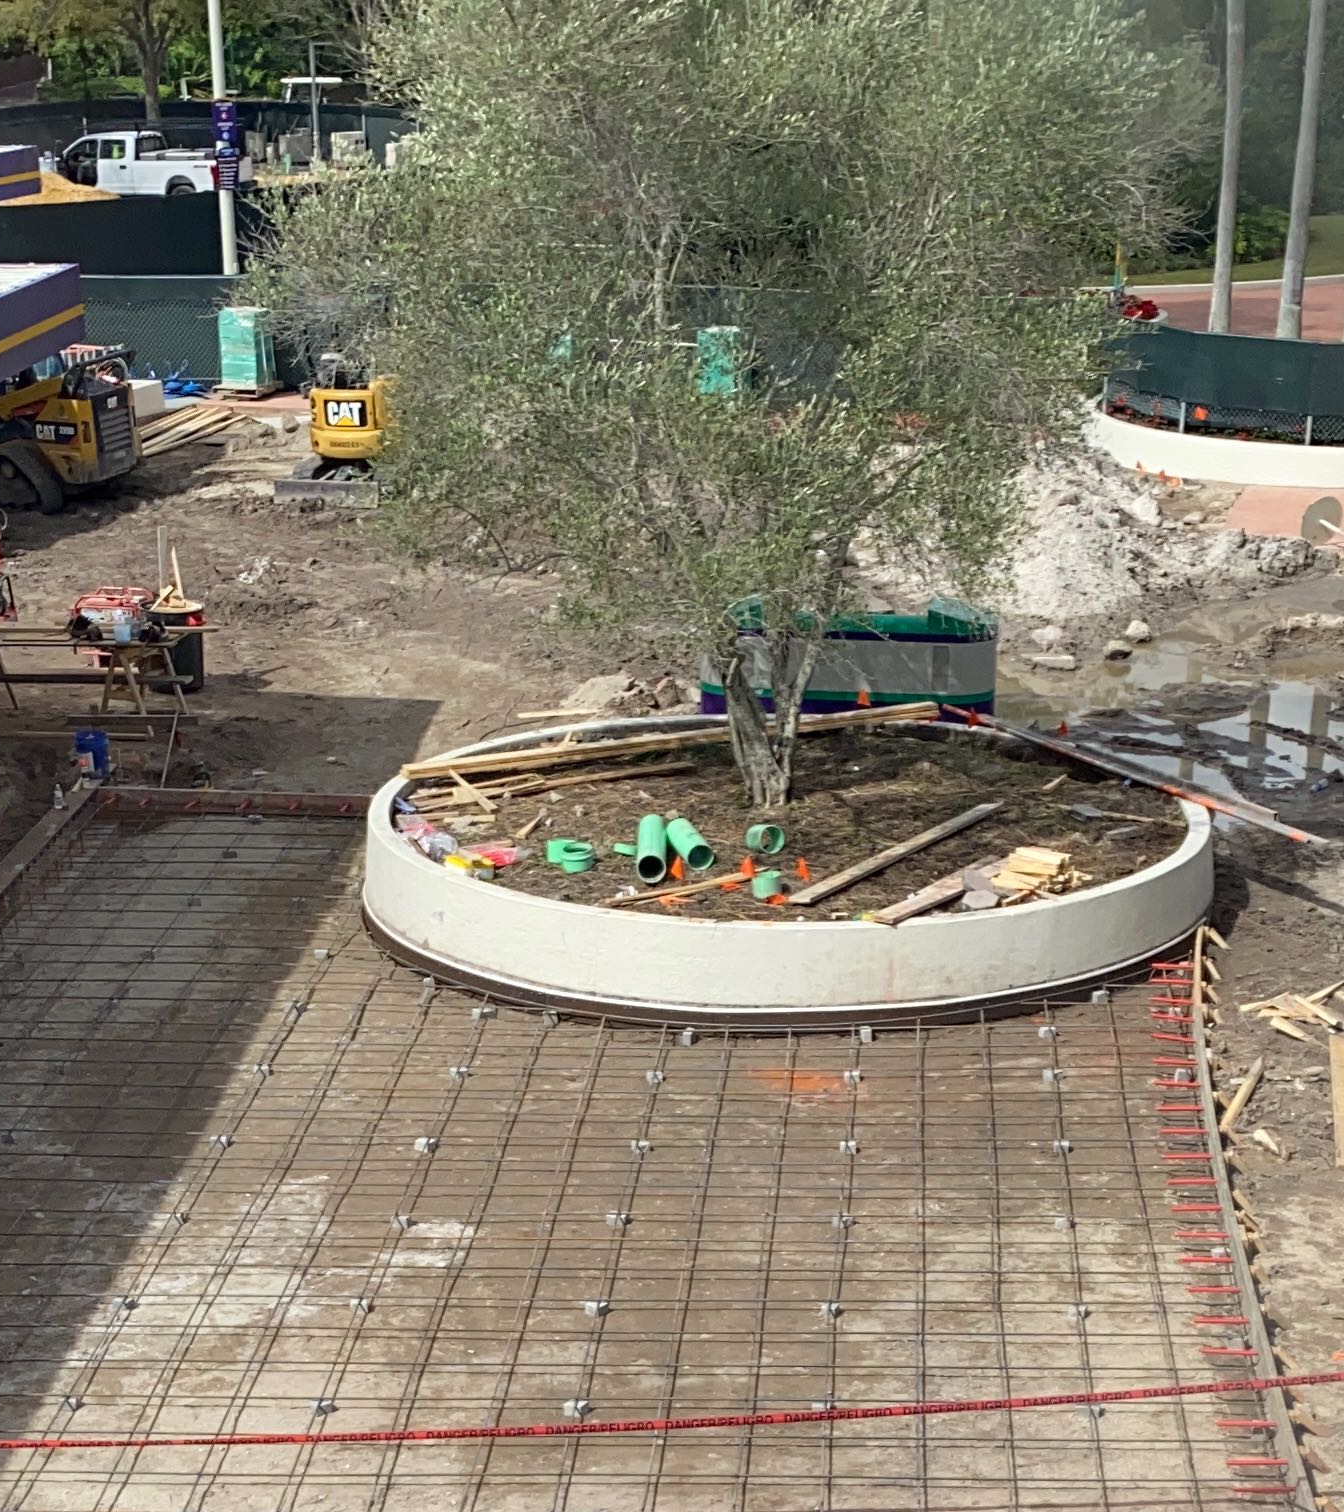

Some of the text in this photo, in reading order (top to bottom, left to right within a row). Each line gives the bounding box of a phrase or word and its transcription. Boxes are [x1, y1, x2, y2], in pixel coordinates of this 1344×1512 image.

[327, 401, 362, 426] CAT
[35, 423, 56, 441] CAT
[784, 1406, 892, 1424] DANGER/PELIGRO
